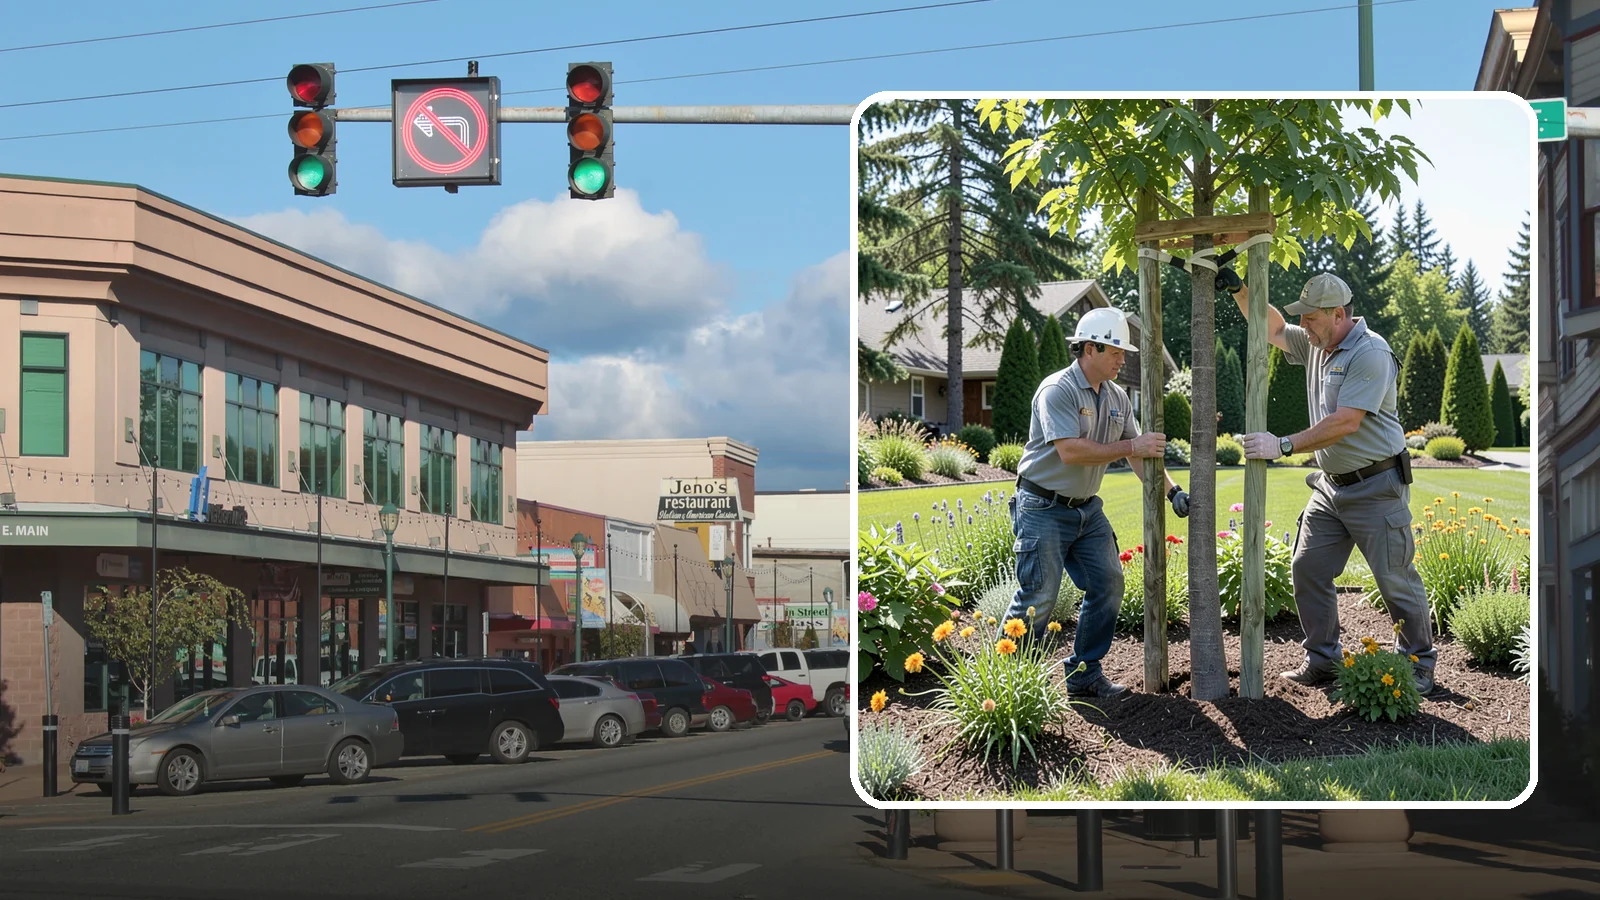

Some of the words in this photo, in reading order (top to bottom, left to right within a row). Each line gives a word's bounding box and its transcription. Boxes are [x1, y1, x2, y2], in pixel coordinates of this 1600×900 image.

[670, 480, 727, 494] Jeno's
[665, 496, 731, 509] restaurant
[659, 510, 681, 519] Italian
[686, 509, 715, 519] American
[715, 510, 737, 519] Cuisine
[2, 525, 13, 536] E.
[15, 525, 49, 536] MAIN
[797, 608, 828, 616] Street
